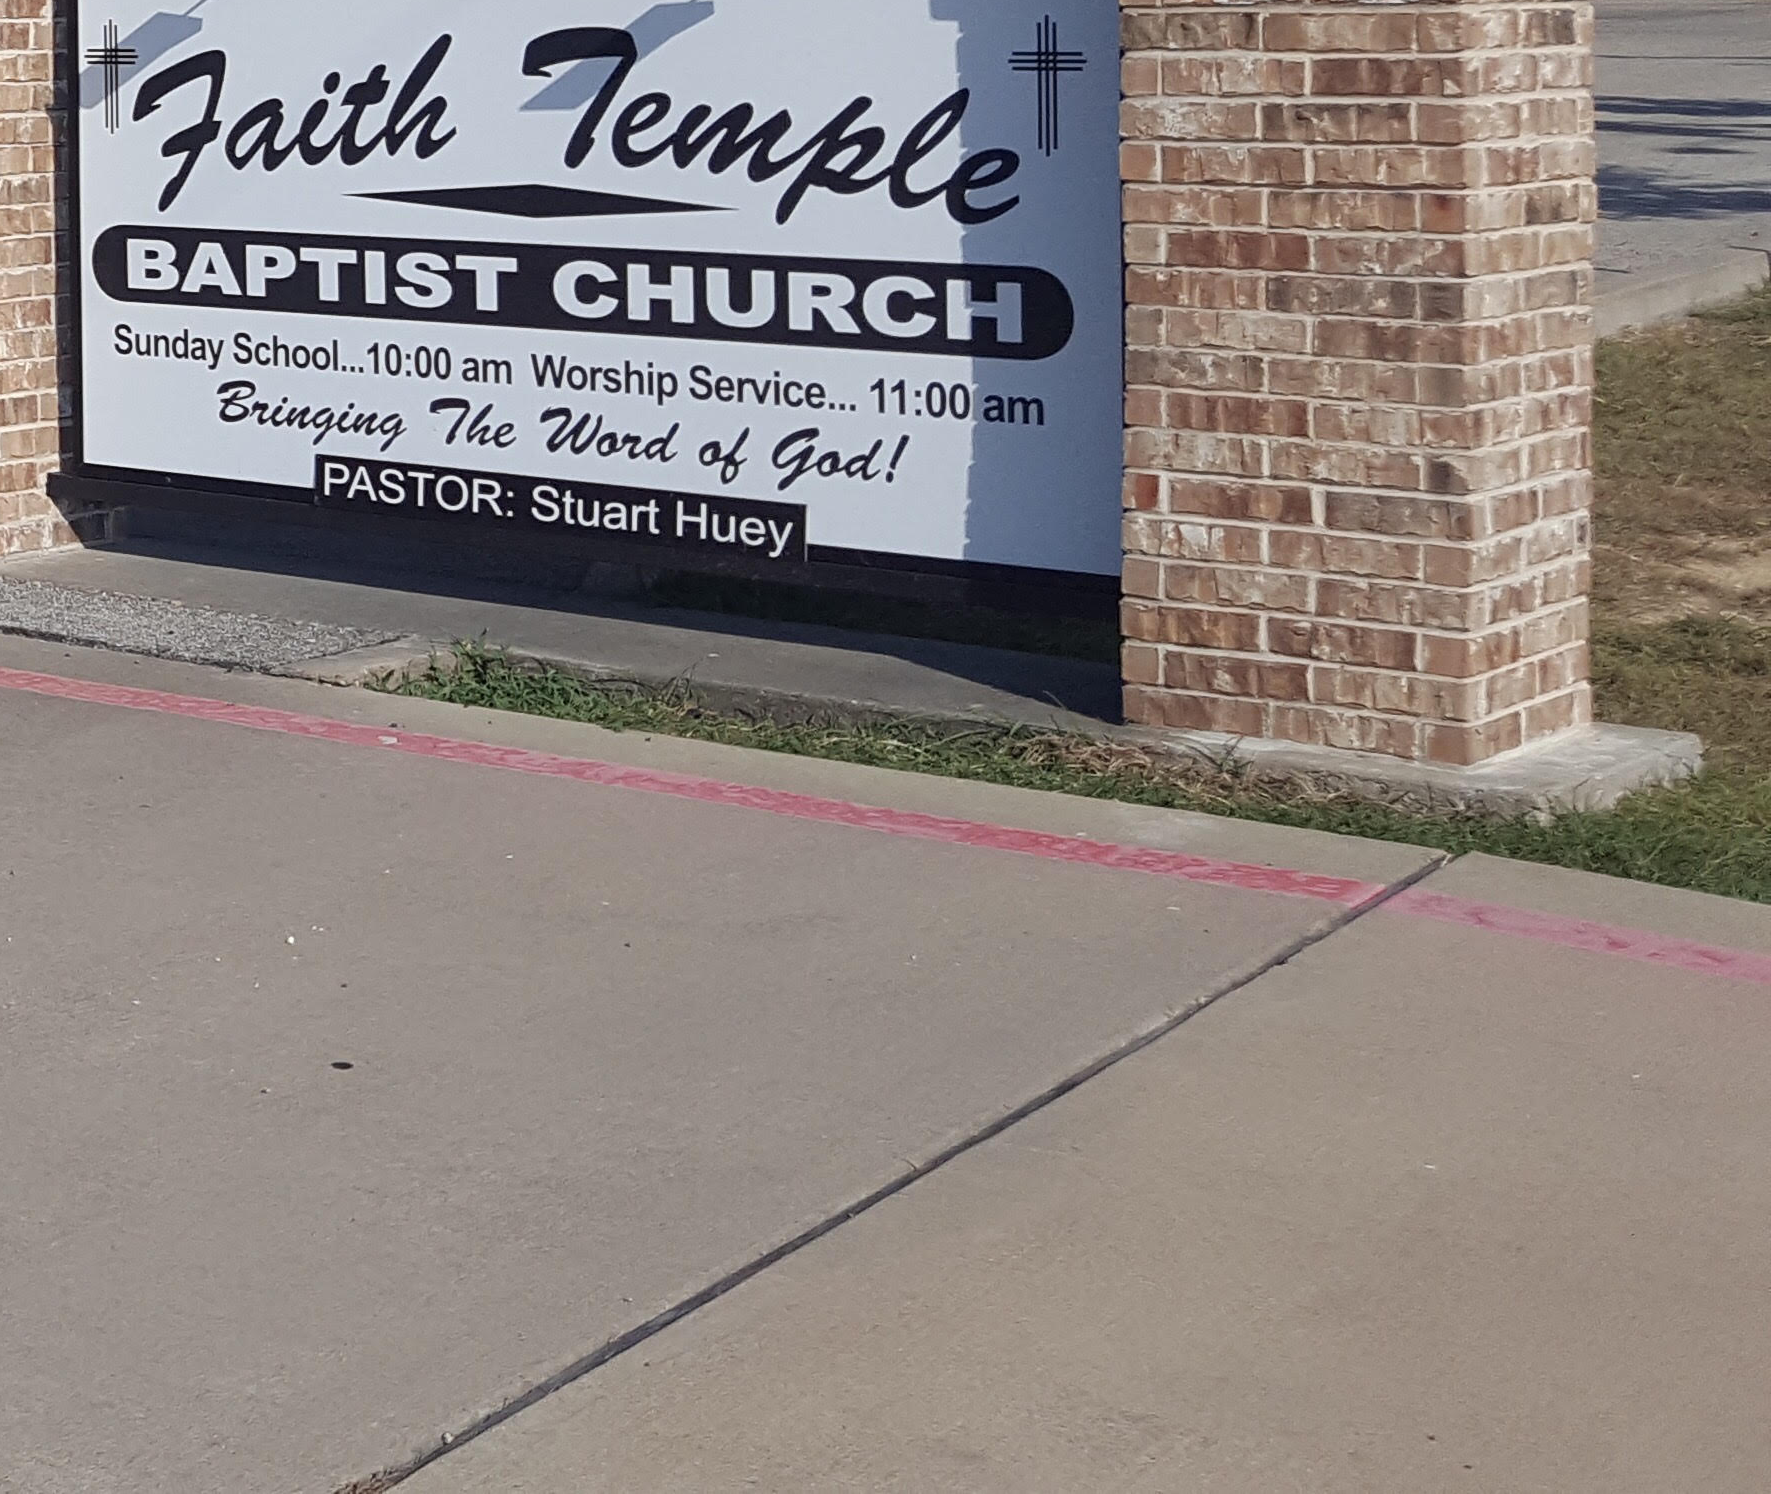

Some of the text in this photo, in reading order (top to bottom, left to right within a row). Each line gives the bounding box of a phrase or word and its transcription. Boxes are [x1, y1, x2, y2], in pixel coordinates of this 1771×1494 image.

[133, 27, 1021, 226] Faith Temple
[126, 238, 1024, 343] BAPTIST CHURCH
[113, 323, 224, 370] Sunday
[462, 357, 512, 385] am
[530, 353, 678, 406] Worship
[689, 365, 856, 413] Service...
[870, 378, 970, 420] 11:00
[982, 394, 1045, 427] am
[217, 380, 910, 491] Bringing The Word of God!
[322, 462, 794, 558] PASTOR: Stuart Huey
